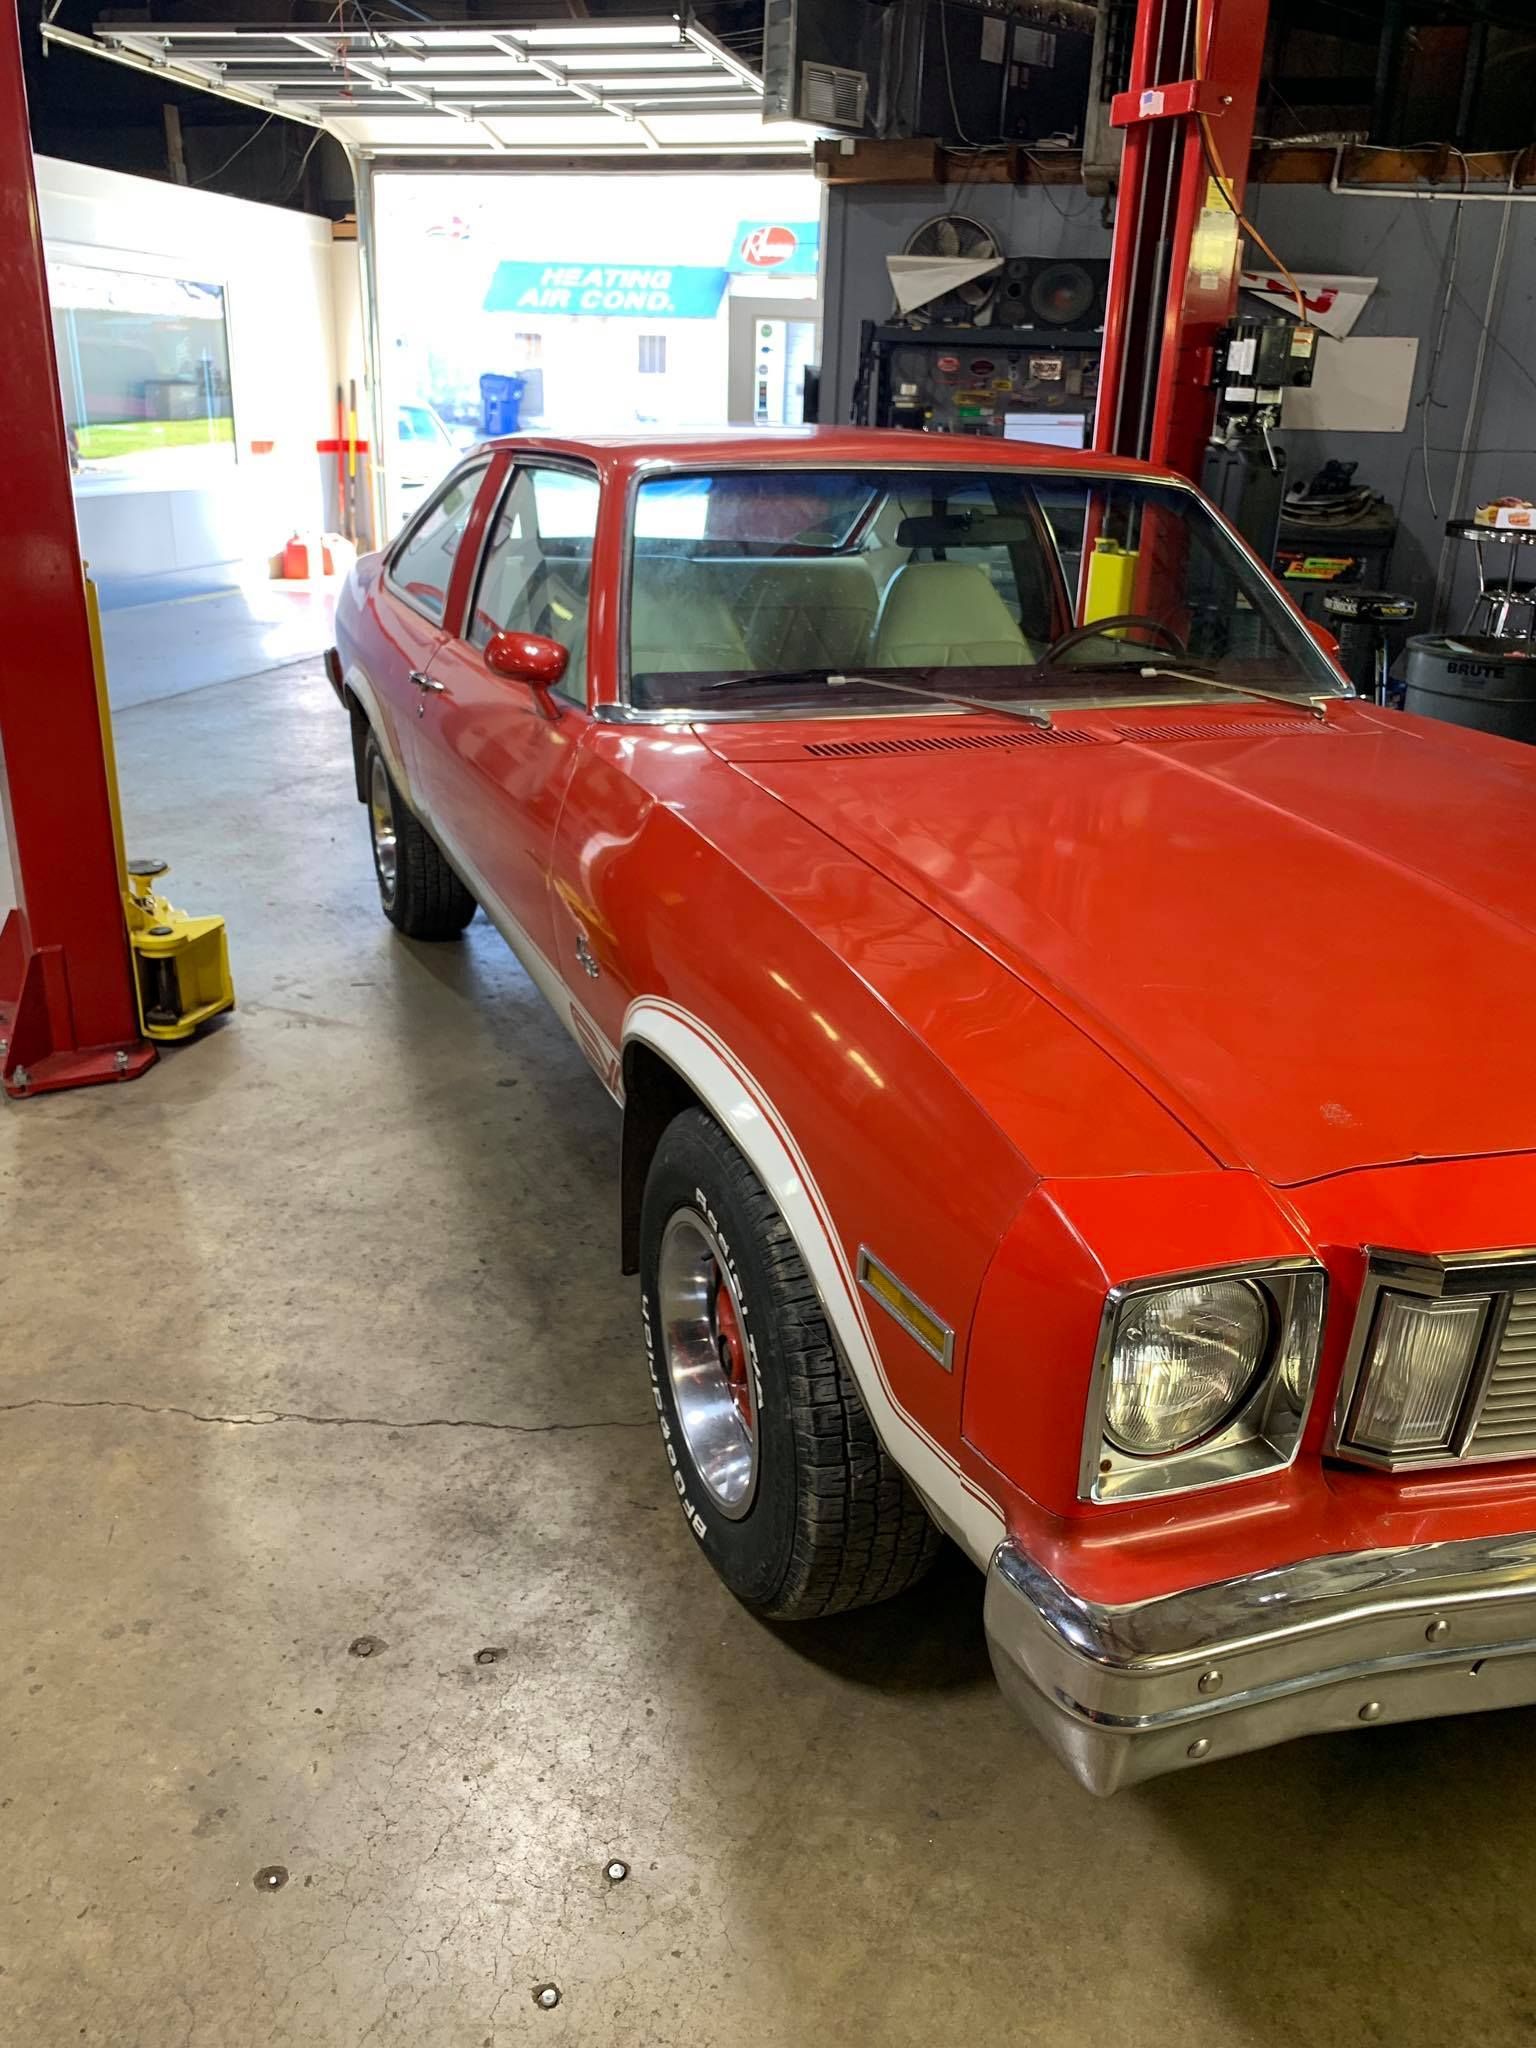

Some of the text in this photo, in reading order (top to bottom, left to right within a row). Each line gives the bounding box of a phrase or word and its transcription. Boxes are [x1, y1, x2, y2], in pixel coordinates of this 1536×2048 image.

[541, 267, 672, 289] HEATING
[517, 288, 675, 311] AIR COND.
[1448, 663, 1504, 679] BRUTE
